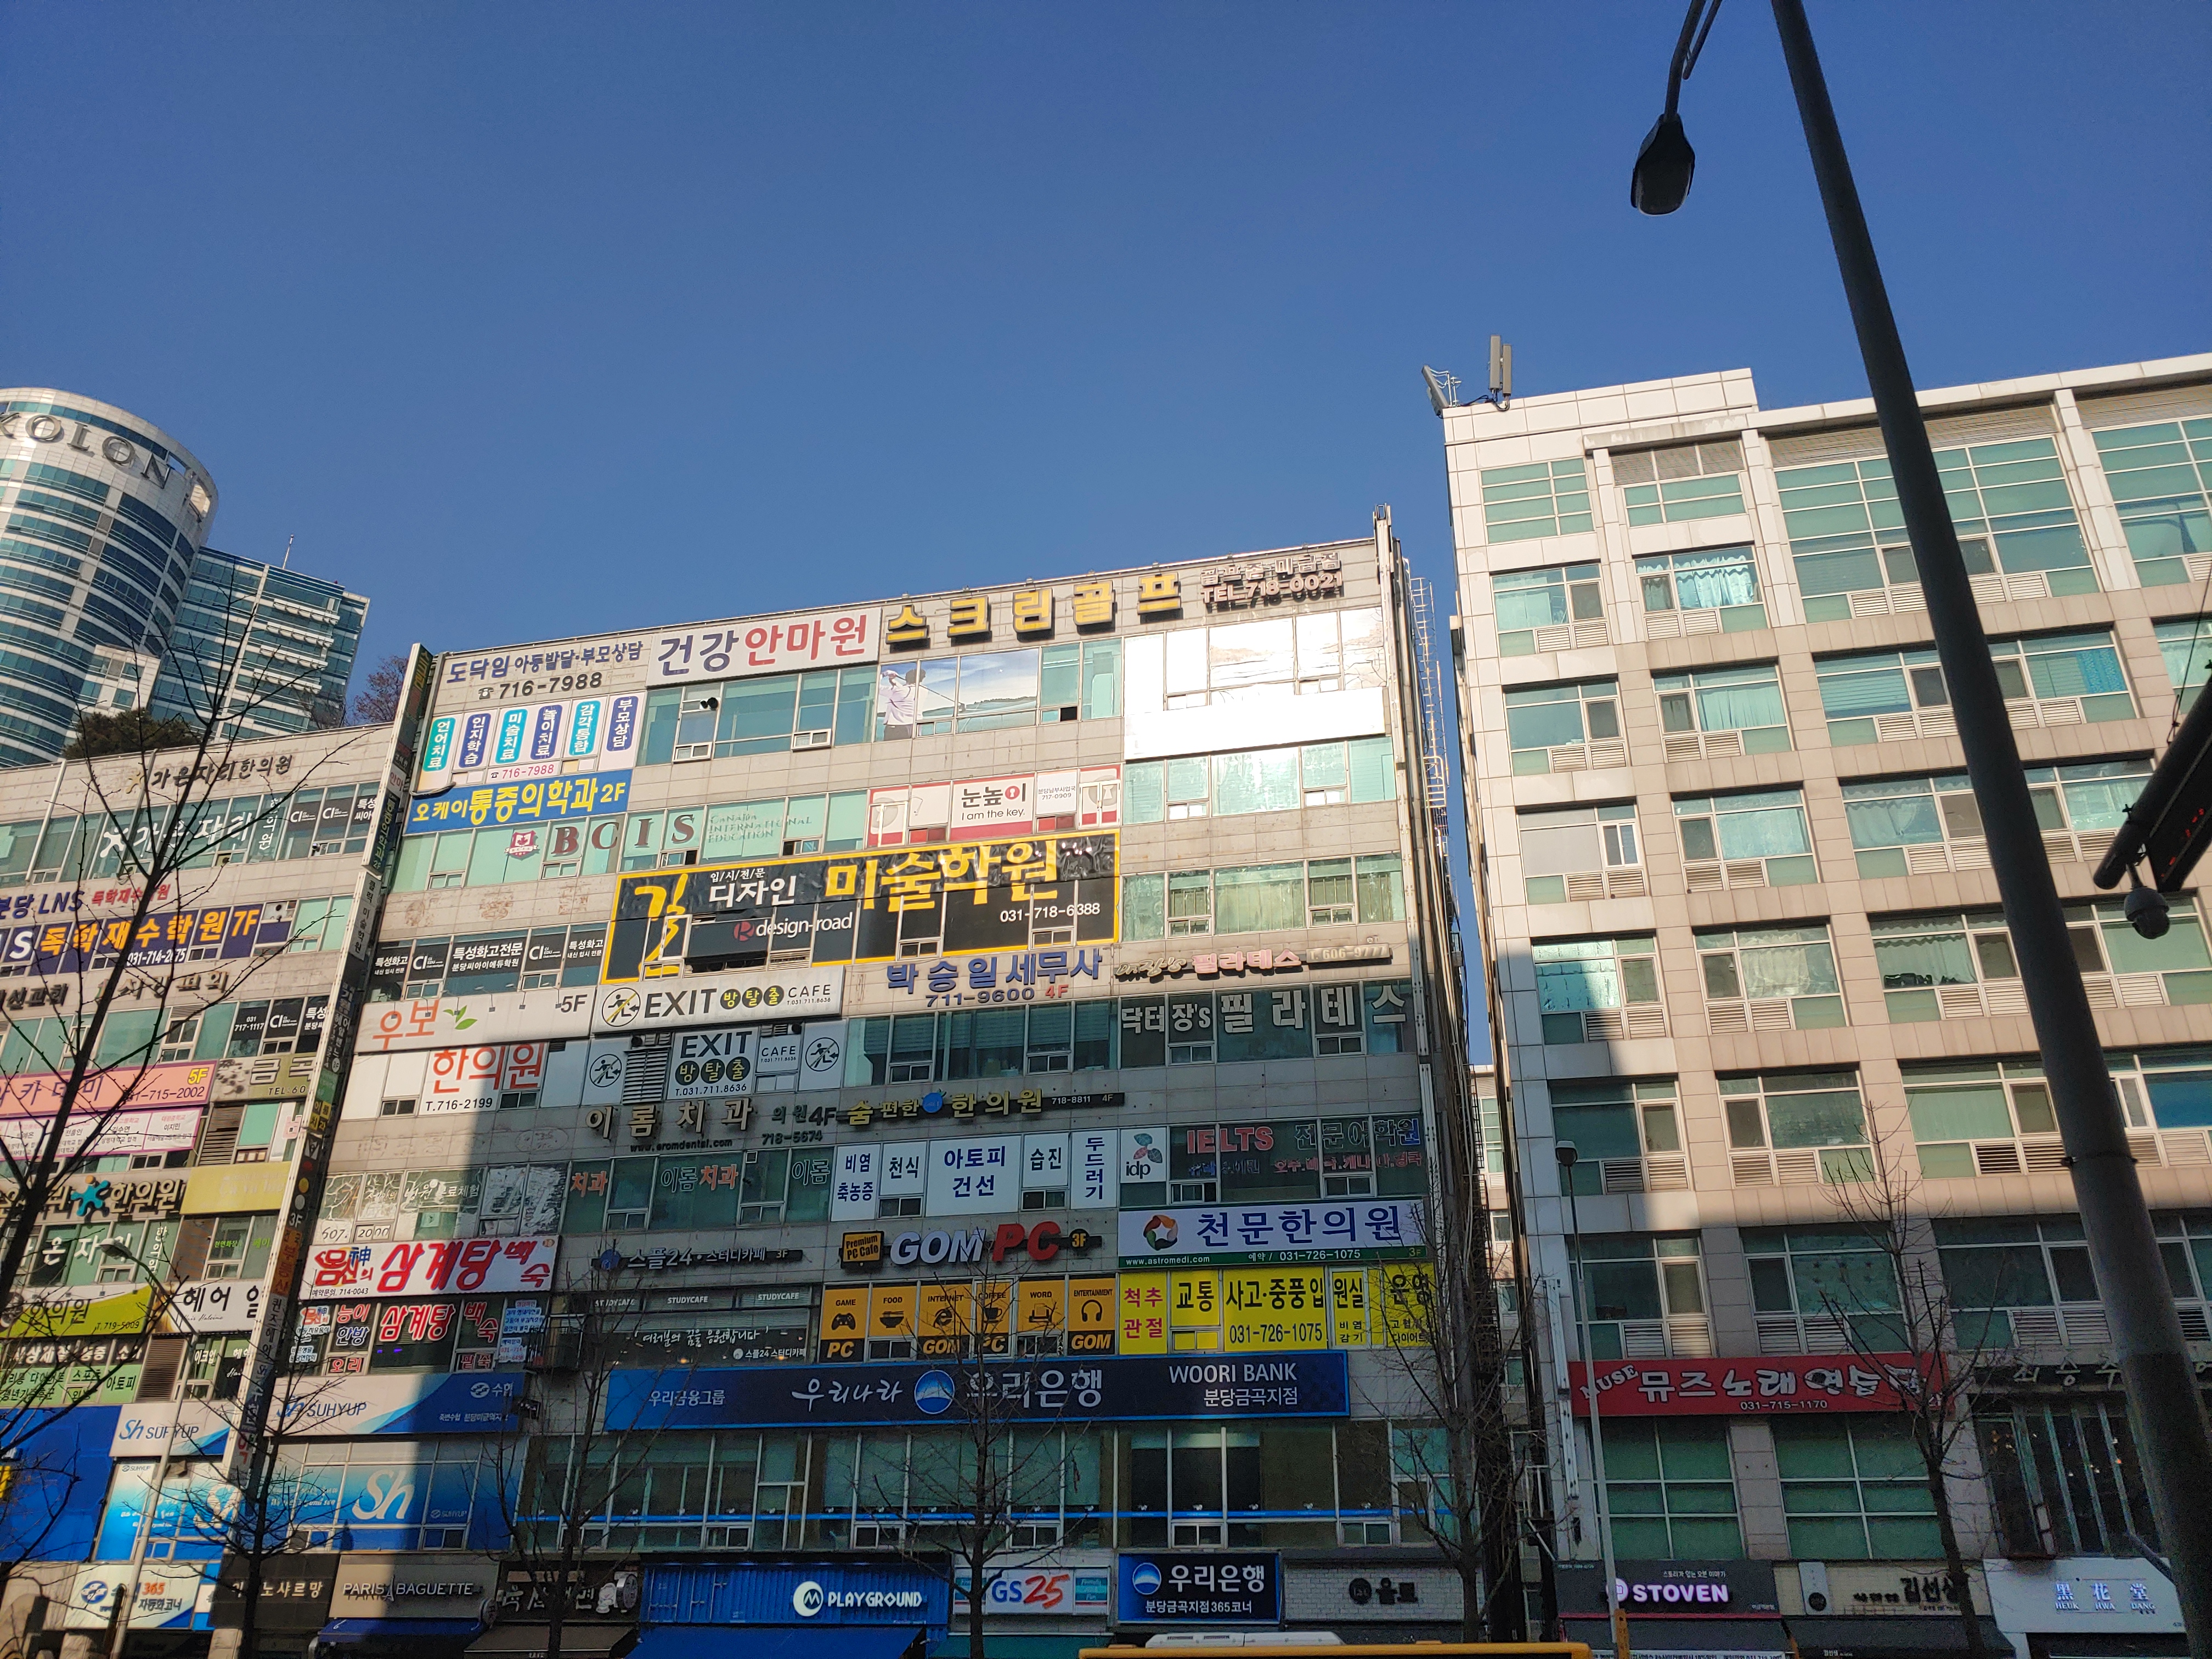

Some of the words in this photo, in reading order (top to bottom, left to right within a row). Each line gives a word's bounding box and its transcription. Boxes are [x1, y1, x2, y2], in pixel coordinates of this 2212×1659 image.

[0, 411, 174, 489] KOLON
[1201, 562, 1264, 586] 골프존
[1275, 552, 1340, 575] 미금점
[885, 573, 1182, 644] 스크린골프
[658, 614, 867, 676] 건강안마원
[447, 656, 510, 684] 도닥임
[499, 672, 603, 699] 716-7988
[535, 708, 558, 757] 놀이치료
[573, 704, 596, 753] 감각통합
[613, 699, 634, 748] 부모상담
[428, 721, 450, 769] 언어치료
[464, 716, 485, 764] 인지학습
[500, 713, 521, 761] 미술치료
[151, 754, 292, 789] 가온자리한의원
[502, 764, 554, 780] 716-7988
[601, 782, 626, 803] 2F
[961, 783, 1026, 808] 눈높이
[1042, 792, 1071, 800] 717-0909
[967, 811, 984, 821] am
[987, 809, 1004, 819] the
[709, 876, 797, 908] 디자인
[825, 840, 1059, 913] 미술학원
[38, 890, 84, 915] LNS
[91, 883, 171, 906] 독학재수원
[1000, 902, 1101, 923] 031-718-6388
[40, 911, 227, 956] 독학재수학원
[231, 909, 261, 937] 7F
[755, 912, 854, 941] design-road
[453, 943, 523, 961] 특성화고전문
[568, 939, 603, 950] 특성화고
[375, 955, 408, 966] 특성화고
[452, 958, 518, 972] 분당씨아이에듀학원
[1191, 949, 1302, 974] 필라테스
[1322, 944, 1390, 960] 606-9777
[644, 988, 718, 1018] EXIT
[723, 986, 779, 1007] 방탈출
[788, 984, 831, 998] CAFE
[925, 988, 1035, 1008] 711-9600
[1044, 984, 1070, 1000] 4F
[1221, 985, 1407, 1034] 필라테스
[234, 1023, 265, 1031] 717-1117
[269, 1015, 282, 1029] CI
[372, 999, 439, 1050] 우보
[561, 994, 588, 1013] 5F
[680, 1031, 753, 1058] EXIT
[761, 1046, 796, 1057] CAFE
[188, 1067, 208, 1085] 5F
[433, 1042, 545, 1094] 한의원
[679, 1059, 744, 1082] 방탈출
[951, 1088, 1042, 1118] 한의원
[1051, 1095, 1091, 1104] 718-8811
[1102, 1093, 1113, 1102] 4F
[585, 1097, 753, 1139] 이롬치과
[771, 1103, 808, 1125] 의원
[808, 1106, 837, 1126] 4F
[1187, 1126, 1274, 1154] IELTS
[844, 1153, 871, 1173] 비염
[889, 1155, 920, 1180] 천식
[944, 1146, 1006, 1170] 아토피
[1030, 1147, 1062, 1170] 습진
[1085, 1137, 1105, 1200] 두드러기
[661, 1164, 739, 1193] 이롬치과
[792, 1159, 831, 1186] 이롬
[1126, 1160, 1151, 1179] idp
[569, 1171, 608, 1198] 치과
[837, 1181, 873, 1202] 축농증
[952, 1176, 995, 1198] 건선
[110, 1179, 182, 1214] 한의원
[289, 1213, 303, 1227] 3F
[1197, 1205, 1402, 1246] 천문한의원
[845, 1234, 878, 1250] Premium
[846, 1248, 858, 1260] PC
[859, 1245, 879, 1259] Cafe
[890, 1228, 986, 1265] GOM
[991, 1221, 1061, 1262] PC
[1071, 1233, 1087, 1248] 3F
[349, 1245, 372, 1266] 神
[776, 1250, 788, 1259] 3F
[1279, 1249, 1361, 1261] 031-726-1075
[377, 1239, 501, 1293] 삼계탕
[504, 1240, 551, 1287] 백숙
[183, 1286, 232, 1313] 헤어
[338, 1288, 369, 1296] 714-0043
[667, 1296, 709, 1304] STUDYCAFE
[757, 1292, 800, 1301] STUDYCAFE
[928, 1294, 964, 1303] INTERNET
[1030, 1290, 1053, 1299] WORD
[1073, 1289, 1113, 1297] ENTERTAINMENT
[1124, 1287, 1164, 1308] 척추
[1176, 1280, 1215, 1312] 교통
[1310, 1277, 1364, 1309] 입원실
[337, 1304, 371, 1323] 능이
[835, 1299, 857, 1307] GAME
[380, 1304, 455, 1342] 삼계탕
[464, 1301, 498, 1343] 백숙
[1123, 1318, 1164, 1339] 관절
[1339, 1319, 1365, 1330] 비염
[336, 1326, 369, 1346] 한방
[642, 1331, 681, 1347] 여러분의
[686, 1329, 702, 1347] 꿈을
[706, 1330, 760, 1344] 응원합니다
[1071, 1334, 1112, 1351] GOM
[1229, 1323, 1323, 1344] 031-726-1075
[1339, 1332, 1364, 1344] 감기
[827, 1342, 854, 1358] PC
[330, 1358, 363, 1373] 오리
[1169, 1364, 1237, 1384] WOORI
[1244, 1362, 1297, 1382] BANK
[106, 1375, 137, 1391] 아토피
[492, 1382, 514, 1397] 수협
[791, 1376, 903, 1412] 우리나라
[967, 1369, 1103, 1408] 우리은행
[648, 1389, 726, 1408] 우리금융그룹
[1204, 1387, 1298, 1407] 분당금곡지점
[1740, 1400, 1829, 1410] 031-715-1170
[306, 1401, 368, 1418] SUHYUP
[119, 1420, 144, 1440] Sh
[352, 1469, 415, 1520] Sh
[142, 1582, 166, 1596] 365
[342, 1582, 385, 1595] PARIS
[396, 1582, 473, 1595] BAGUETTE
[1168, 1564, 1265, 1593] 우리은행
[828, 1592, 923, 1608] PLAYGROUND
[991, 1573, 1070, 1609] GS25
[1632, 1584, 1730, 1603] STOVEN
[137, 1598, 182, 1612] 자동화코너
[1145, 1600, 1209, 1614] 분당금곡지점
[2055, 1602, 2080, 1611] HEUK
[2095, 1602, 2116, 1611] HWA
[2131, 1601, 2157, 1611] DANG
